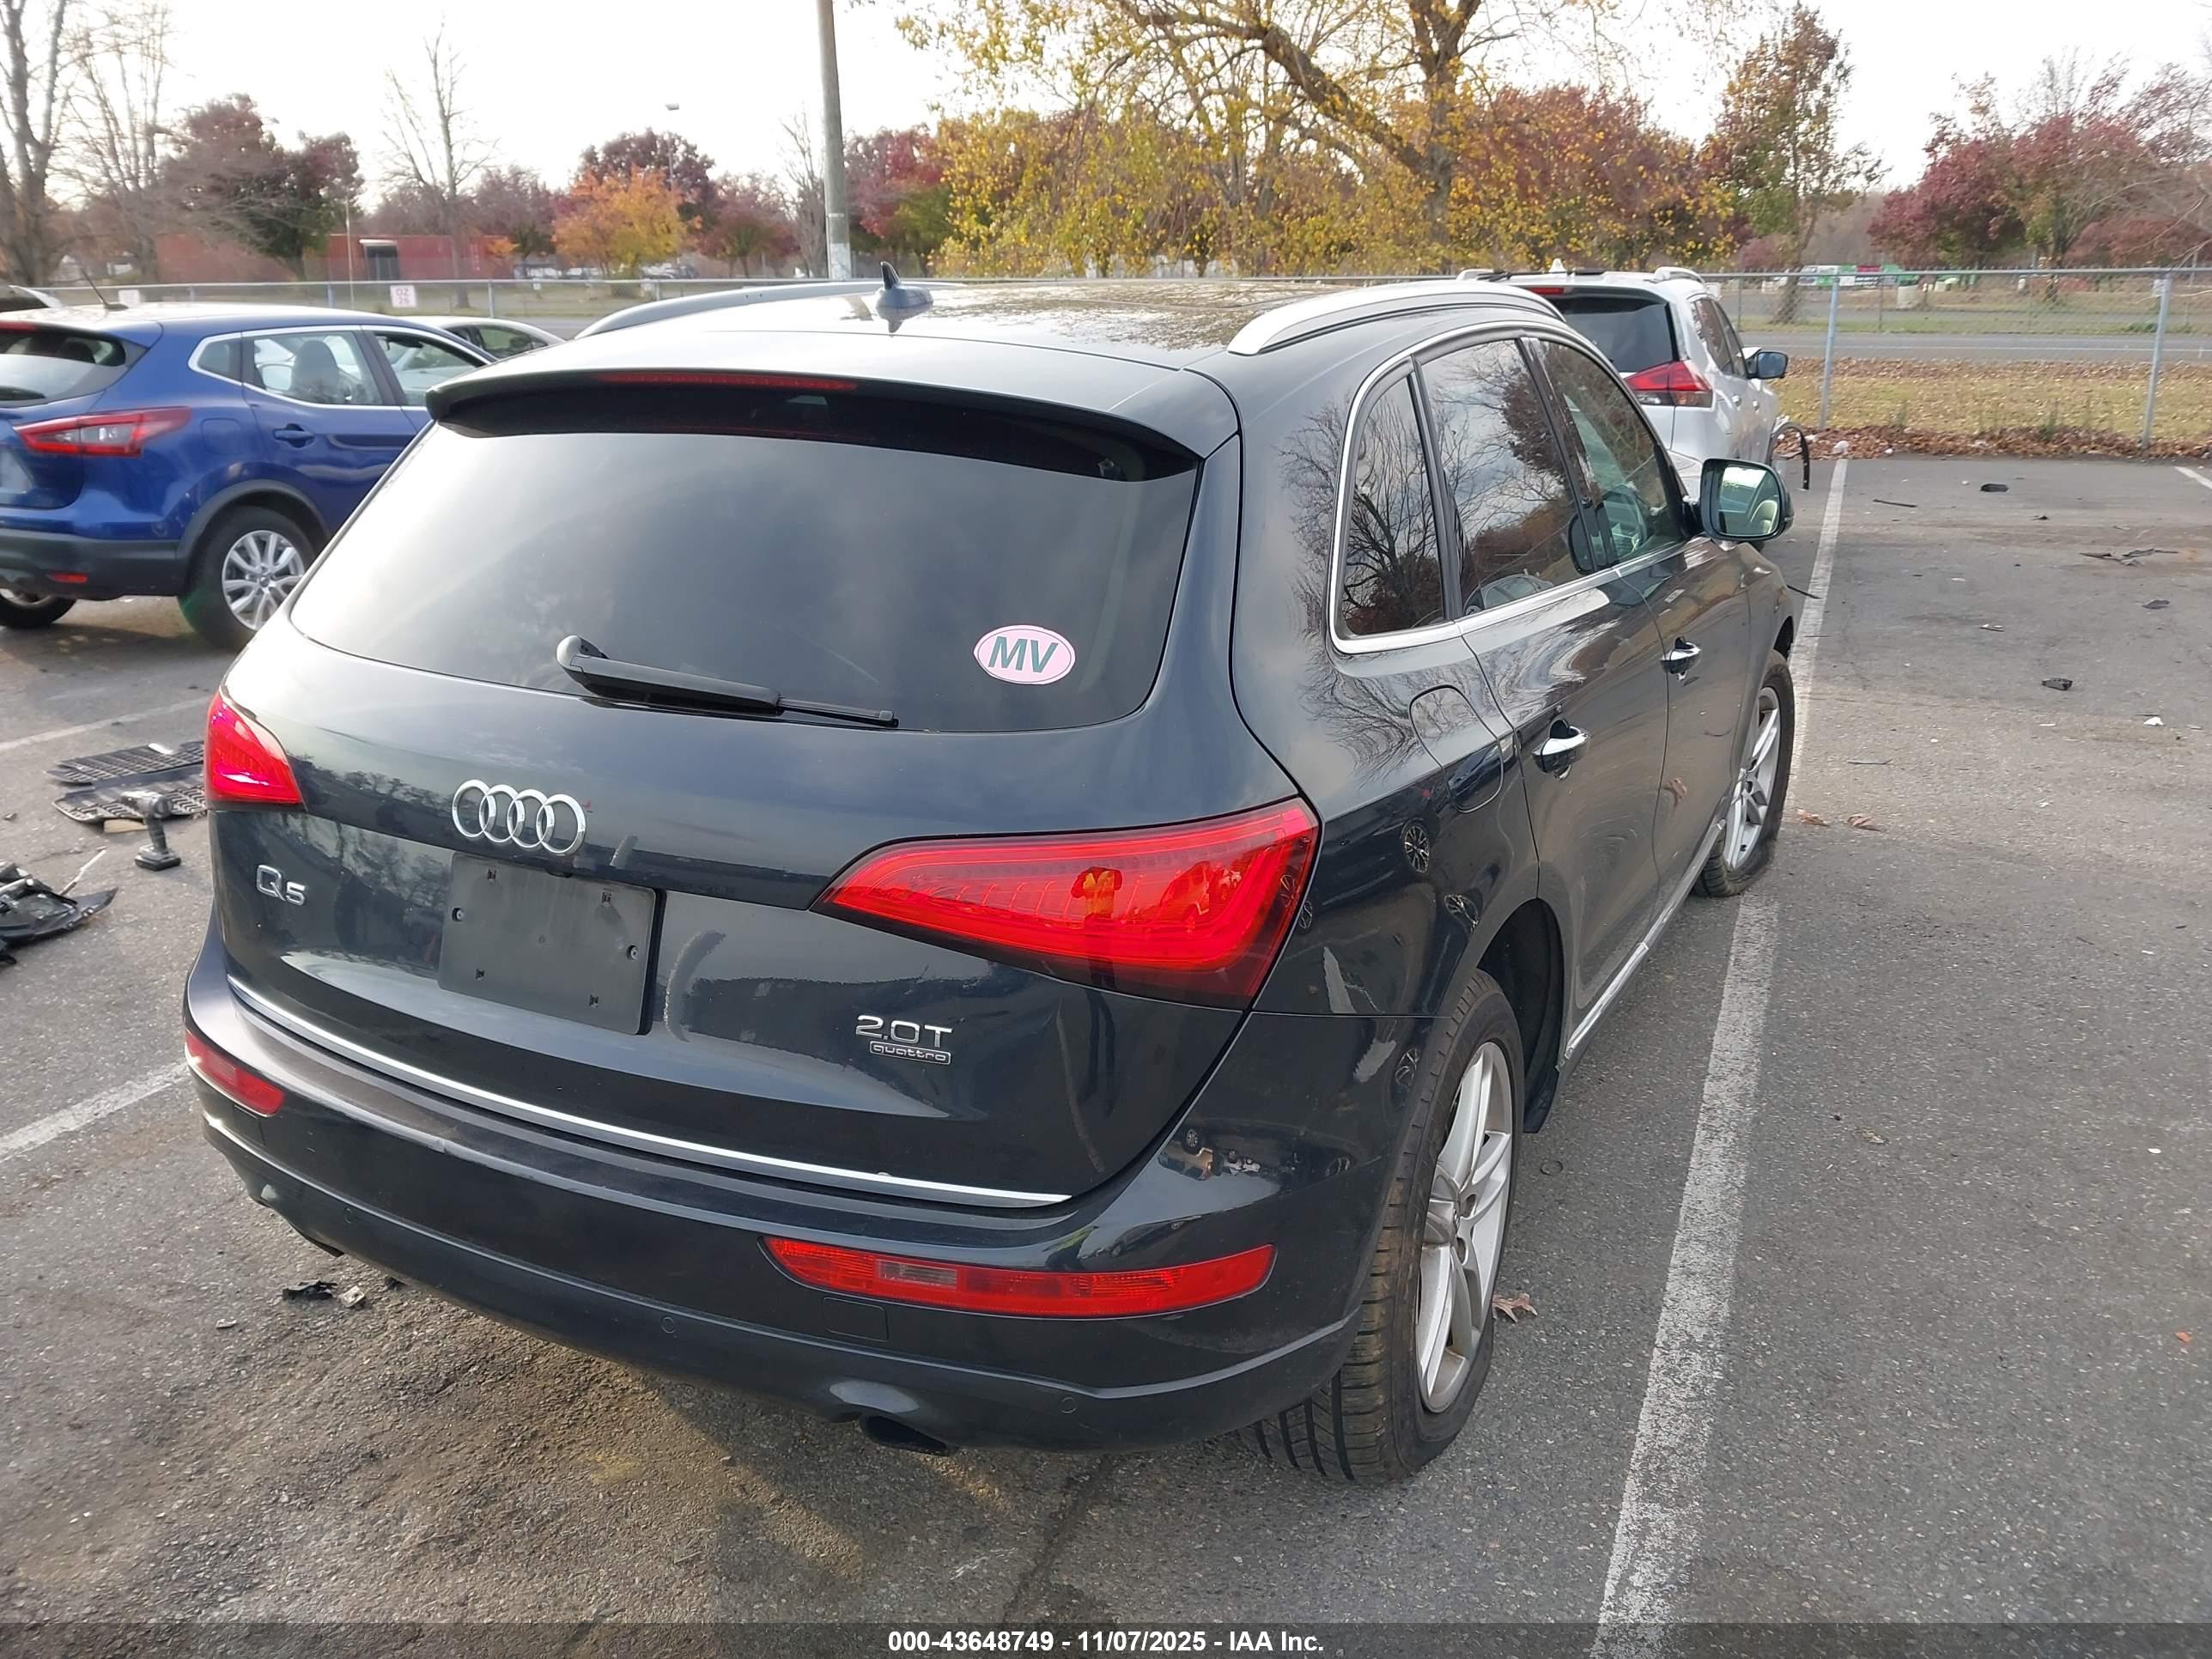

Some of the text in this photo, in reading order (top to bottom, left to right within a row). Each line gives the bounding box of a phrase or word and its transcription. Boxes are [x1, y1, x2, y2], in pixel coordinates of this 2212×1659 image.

[988, 635, 1059, 673] MV
[257, 864, 306, 906] Q5
[855, 1014, 953, 1048] 2.0T
[872, 1043, 947, 1061] quattro
